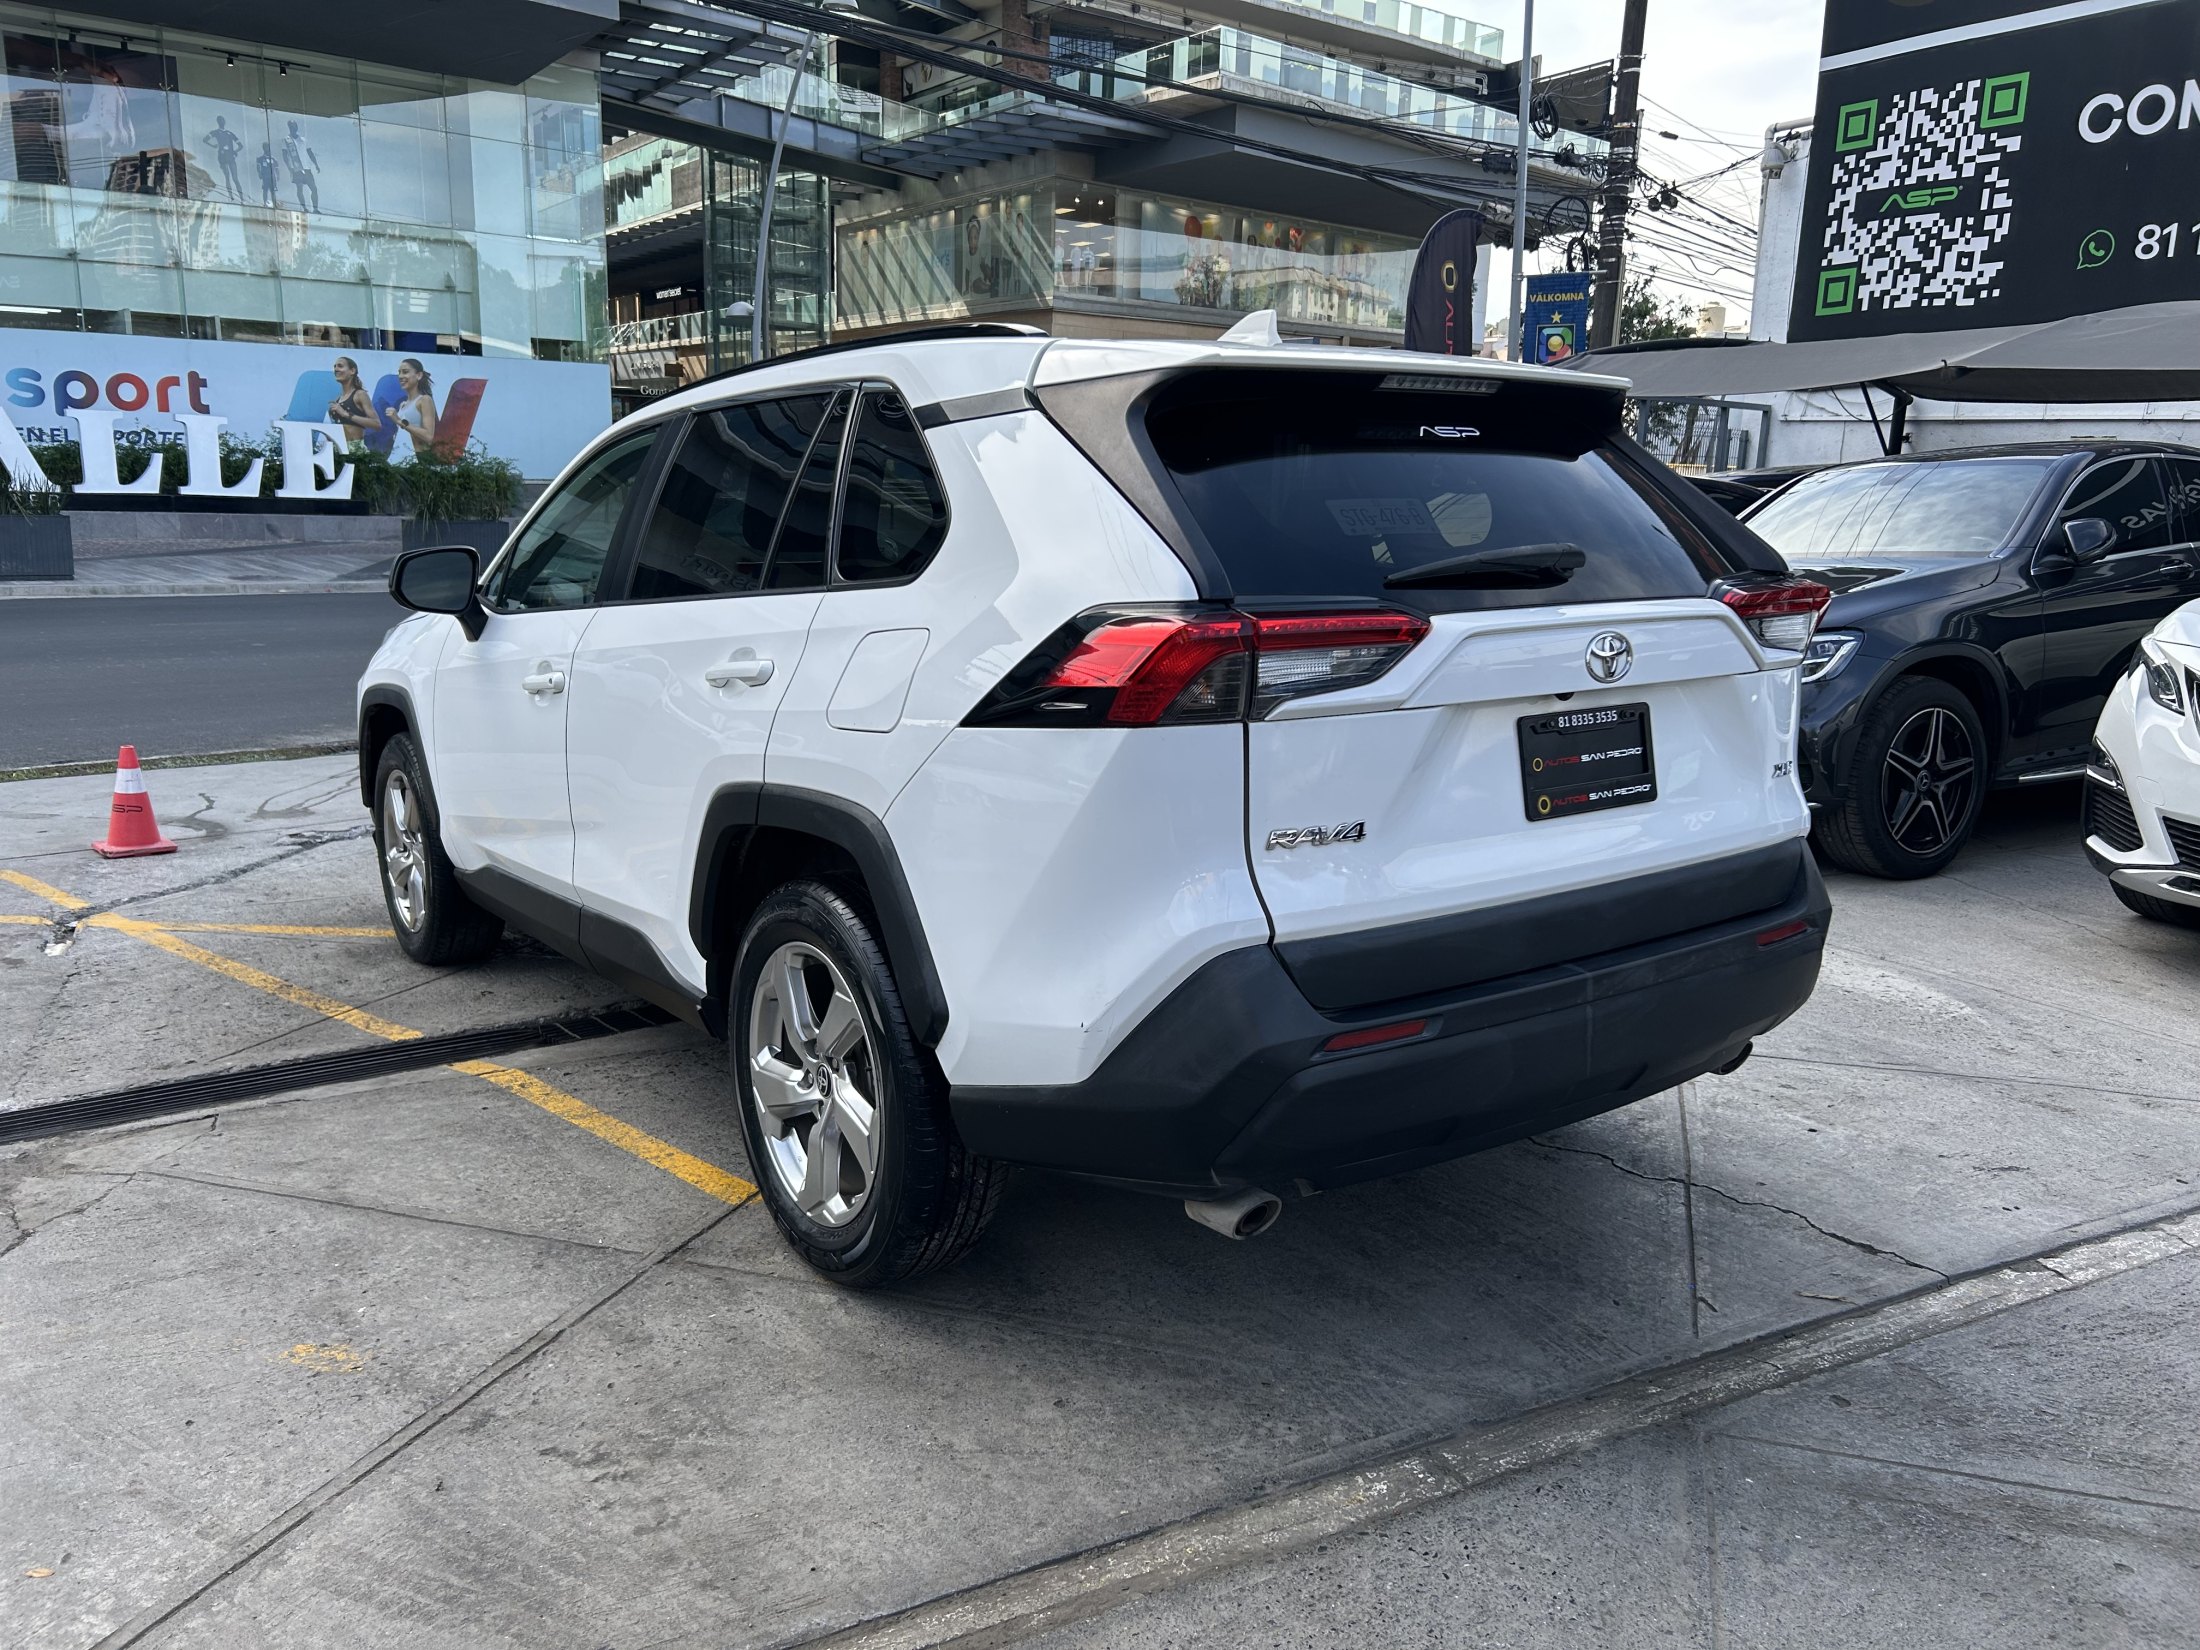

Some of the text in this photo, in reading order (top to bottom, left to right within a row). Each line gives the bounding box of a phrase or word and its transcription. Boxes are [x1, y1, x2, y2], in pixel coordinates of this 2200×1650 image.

[1879, 186, 1959, 213] ASP
[2134, 222, 2179, 260] 81
[1529, 291, 1585, 303] VÄLKOMNA
[5, 367, 211, 417] sport
[1558, 710, 1618, 728] 81 8335 3535
[1544, 747, 1642, 768] AUTOS SAN PEDRO
[1552, 784, 1650, 807] AUTOS SAN PEDRO
[1265, 819, 1367, 851] RAV4
